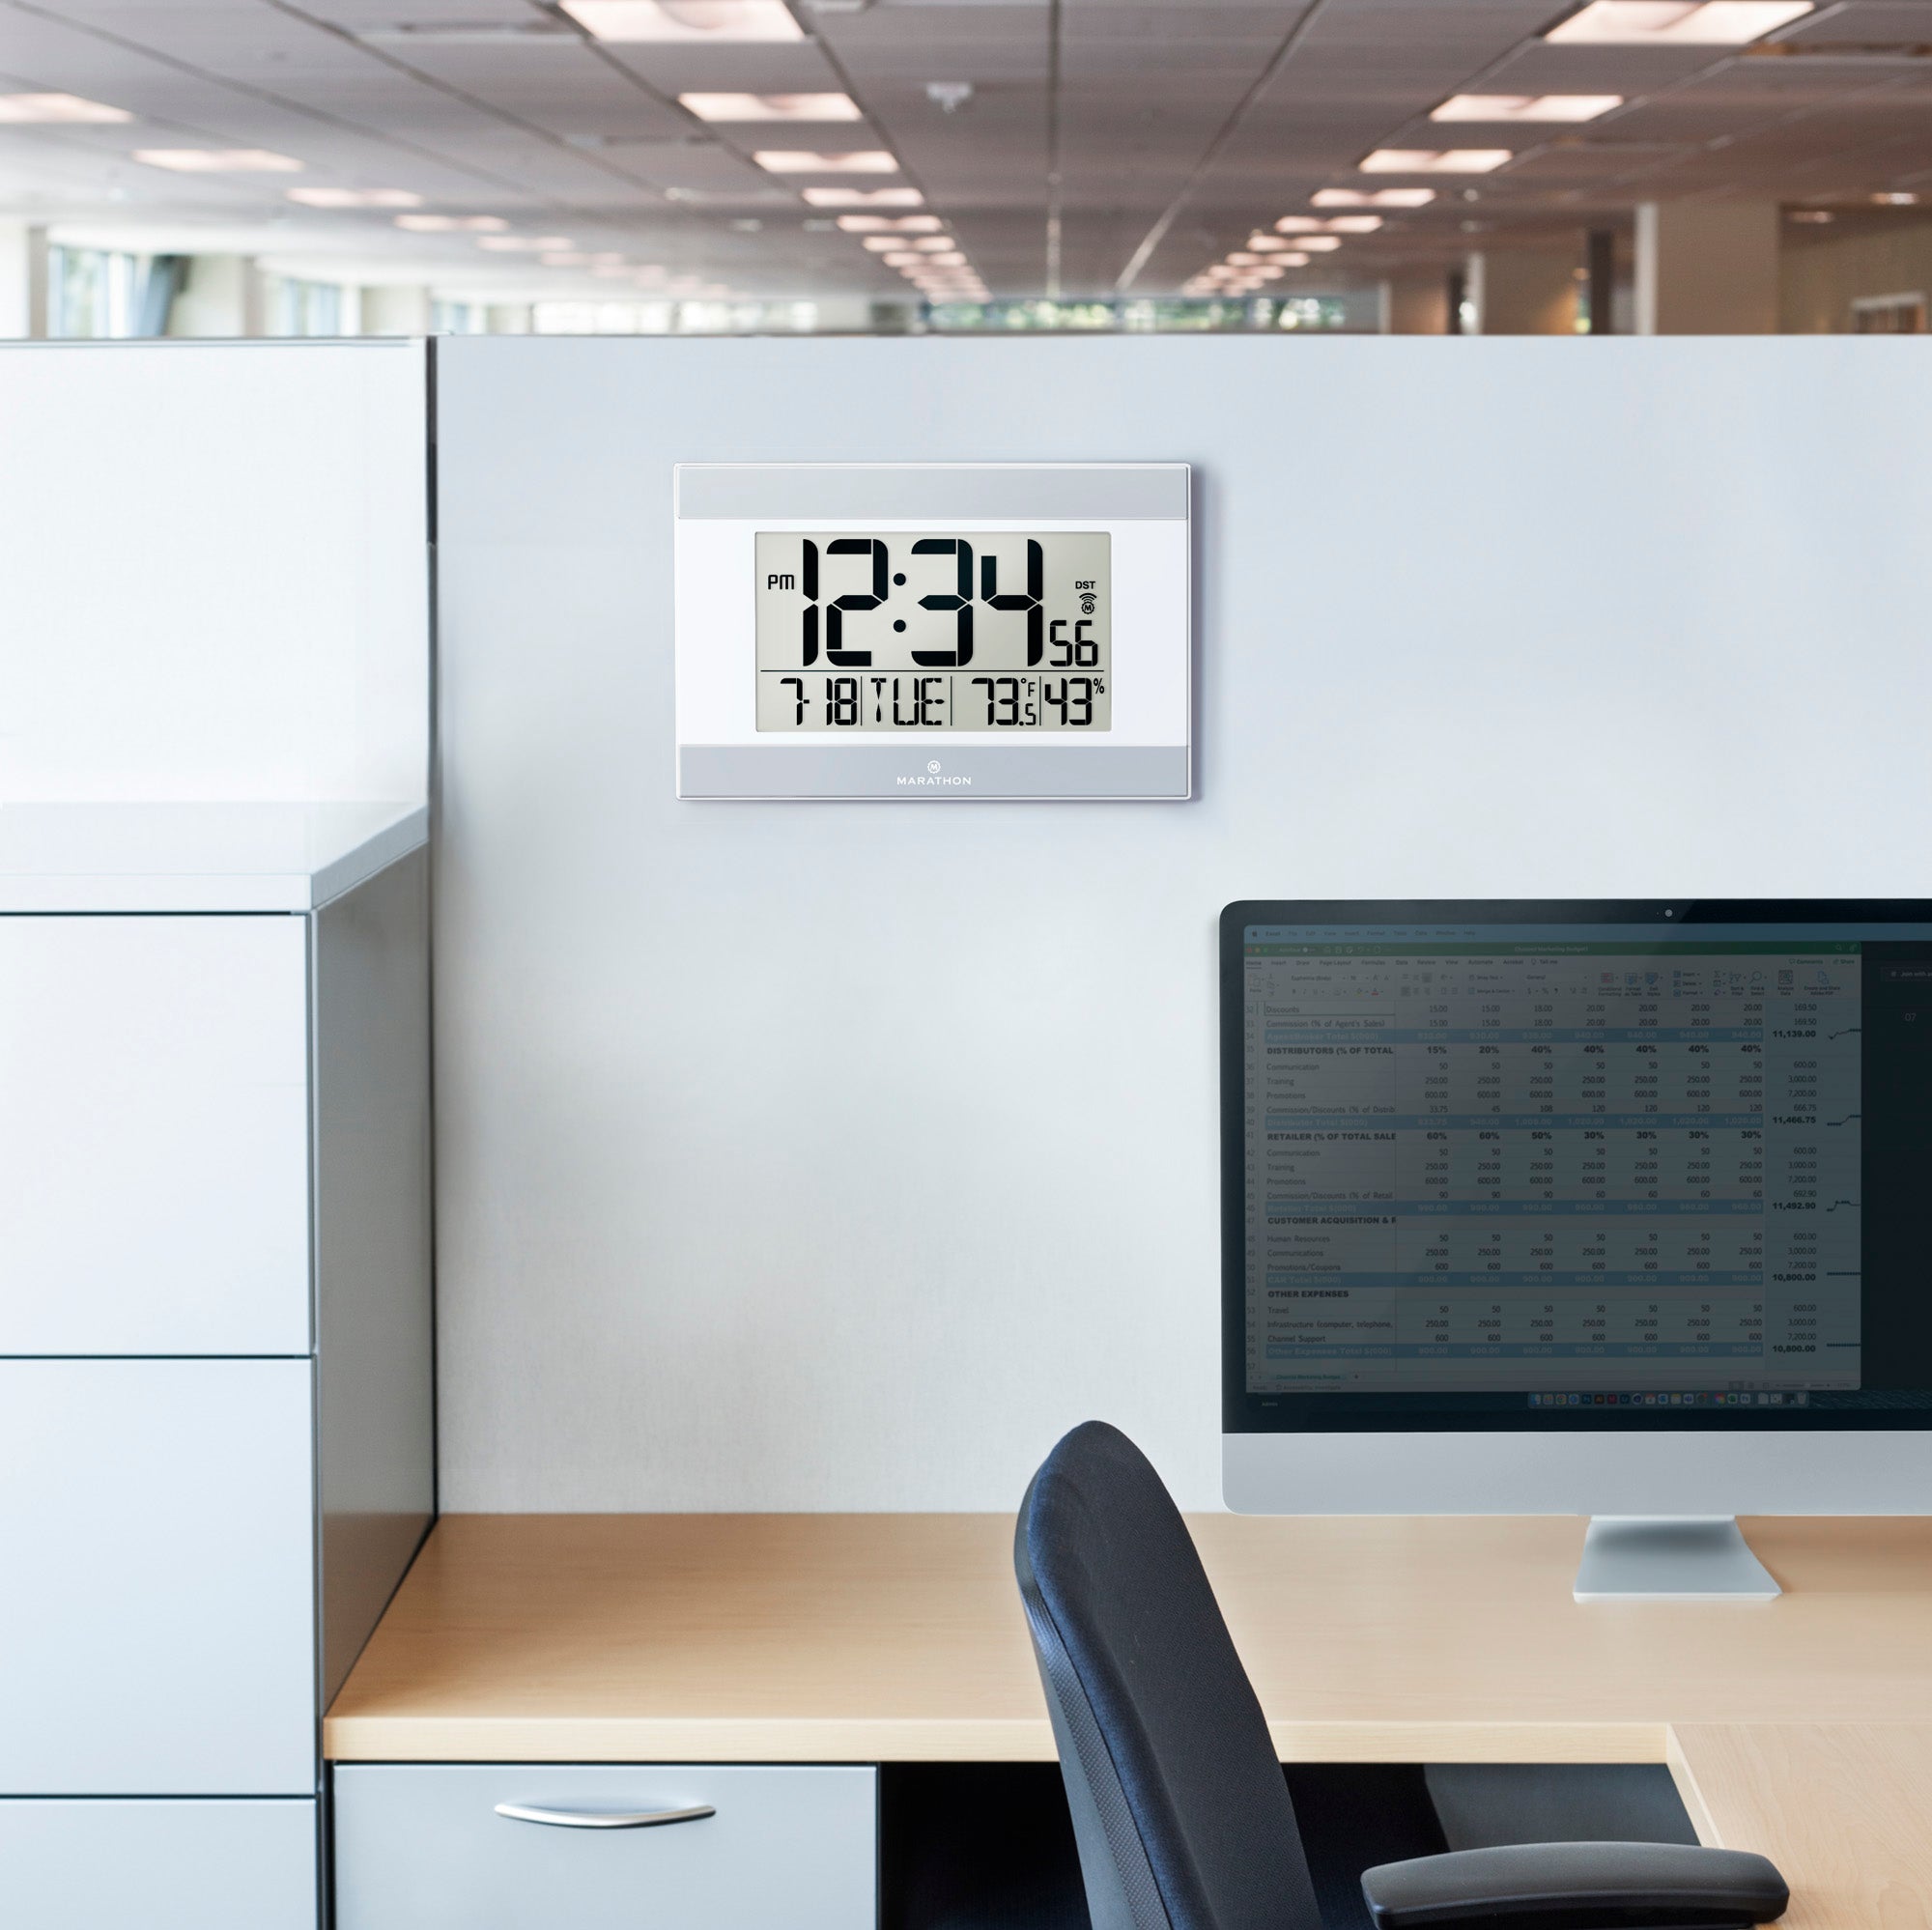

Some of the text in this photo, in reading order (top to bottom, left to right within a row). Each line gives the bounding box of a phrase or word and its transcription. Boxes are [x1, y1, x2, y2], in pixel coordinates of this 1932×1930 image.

[767, 574, 794, 590] PM
[1075, 581, 1095, 589] DST
[803, 538, 1043, 667] 12:34
[1049, 619, 1098, 667] 56
[870, 677, 945, 725] TUE
[896, 777, 971, 785] MARATHON
[1638, 1004, 1658, 1012] 20.00
[1691, 1004, 1711, 1012] 20.00
[1744, 1004, 1763, 1012] 20.00
[1429, 1019, 1448, 1028] 15.00
[1586, 1018, 1605, 1027] 20.00
[1638, 1018, 1658, 1027] 20.00
[1691, 1018, 1711, 1027] 20.00
[1266, 1047, 1394, 1057] DISTRIBUTORS (% OF TOTAL
[1427, 1046, 1447, 1055] 15%
[1583, 1045, 1605, 1054] 40%
[1636, 1045, 1657, 1054] 40%
[1741, 1044, 1761, 1053] 40%
[1492, 1105, 1501, 1114] 45
[1644, 1104, 1658, 1113] 120
[1696, 1104, 1711, 1113] 120
[1266, 1133, 1312, 1142] RETAILER
[1314, 1133, 1325, 1143] (%
[1326, 1133, 1340, 1142] OF
[1341, 1133, 1372, 1142] TOTAL
[1427, 1132, 1447, 1141] 60%
[1583, 1131, 1605, 1140] 30%
[1636, 1131, 1657, 1140] 30%
[1741, 1130, 1761, 1139] 30%
[1267, 1216, 1320, 1225] CUSTOMER
[1321, 1216, 1379, 1225] ACQUISITION
[1381, 1216, 1389, 1225] &
[1487, 1263, 1501, 1271] 600
[1592, 1262, 1605, 1270] 600
[1696, 1262, 1711, 1270] 600
[1267, 1290, 1350, 1298] OTHER EXPENSES
[1425, 1320, 1448, 1328] 250.00
[1477, 1320, 1501, 1328] 250.00
[1582, 1319, 1605, 1327] 250.00
[1634, 1319, 1658, 1327] 250.00
[1687, 1319, 1711, 1327] 250.00
[1739, 1319, 1763, 1327] 250.00
